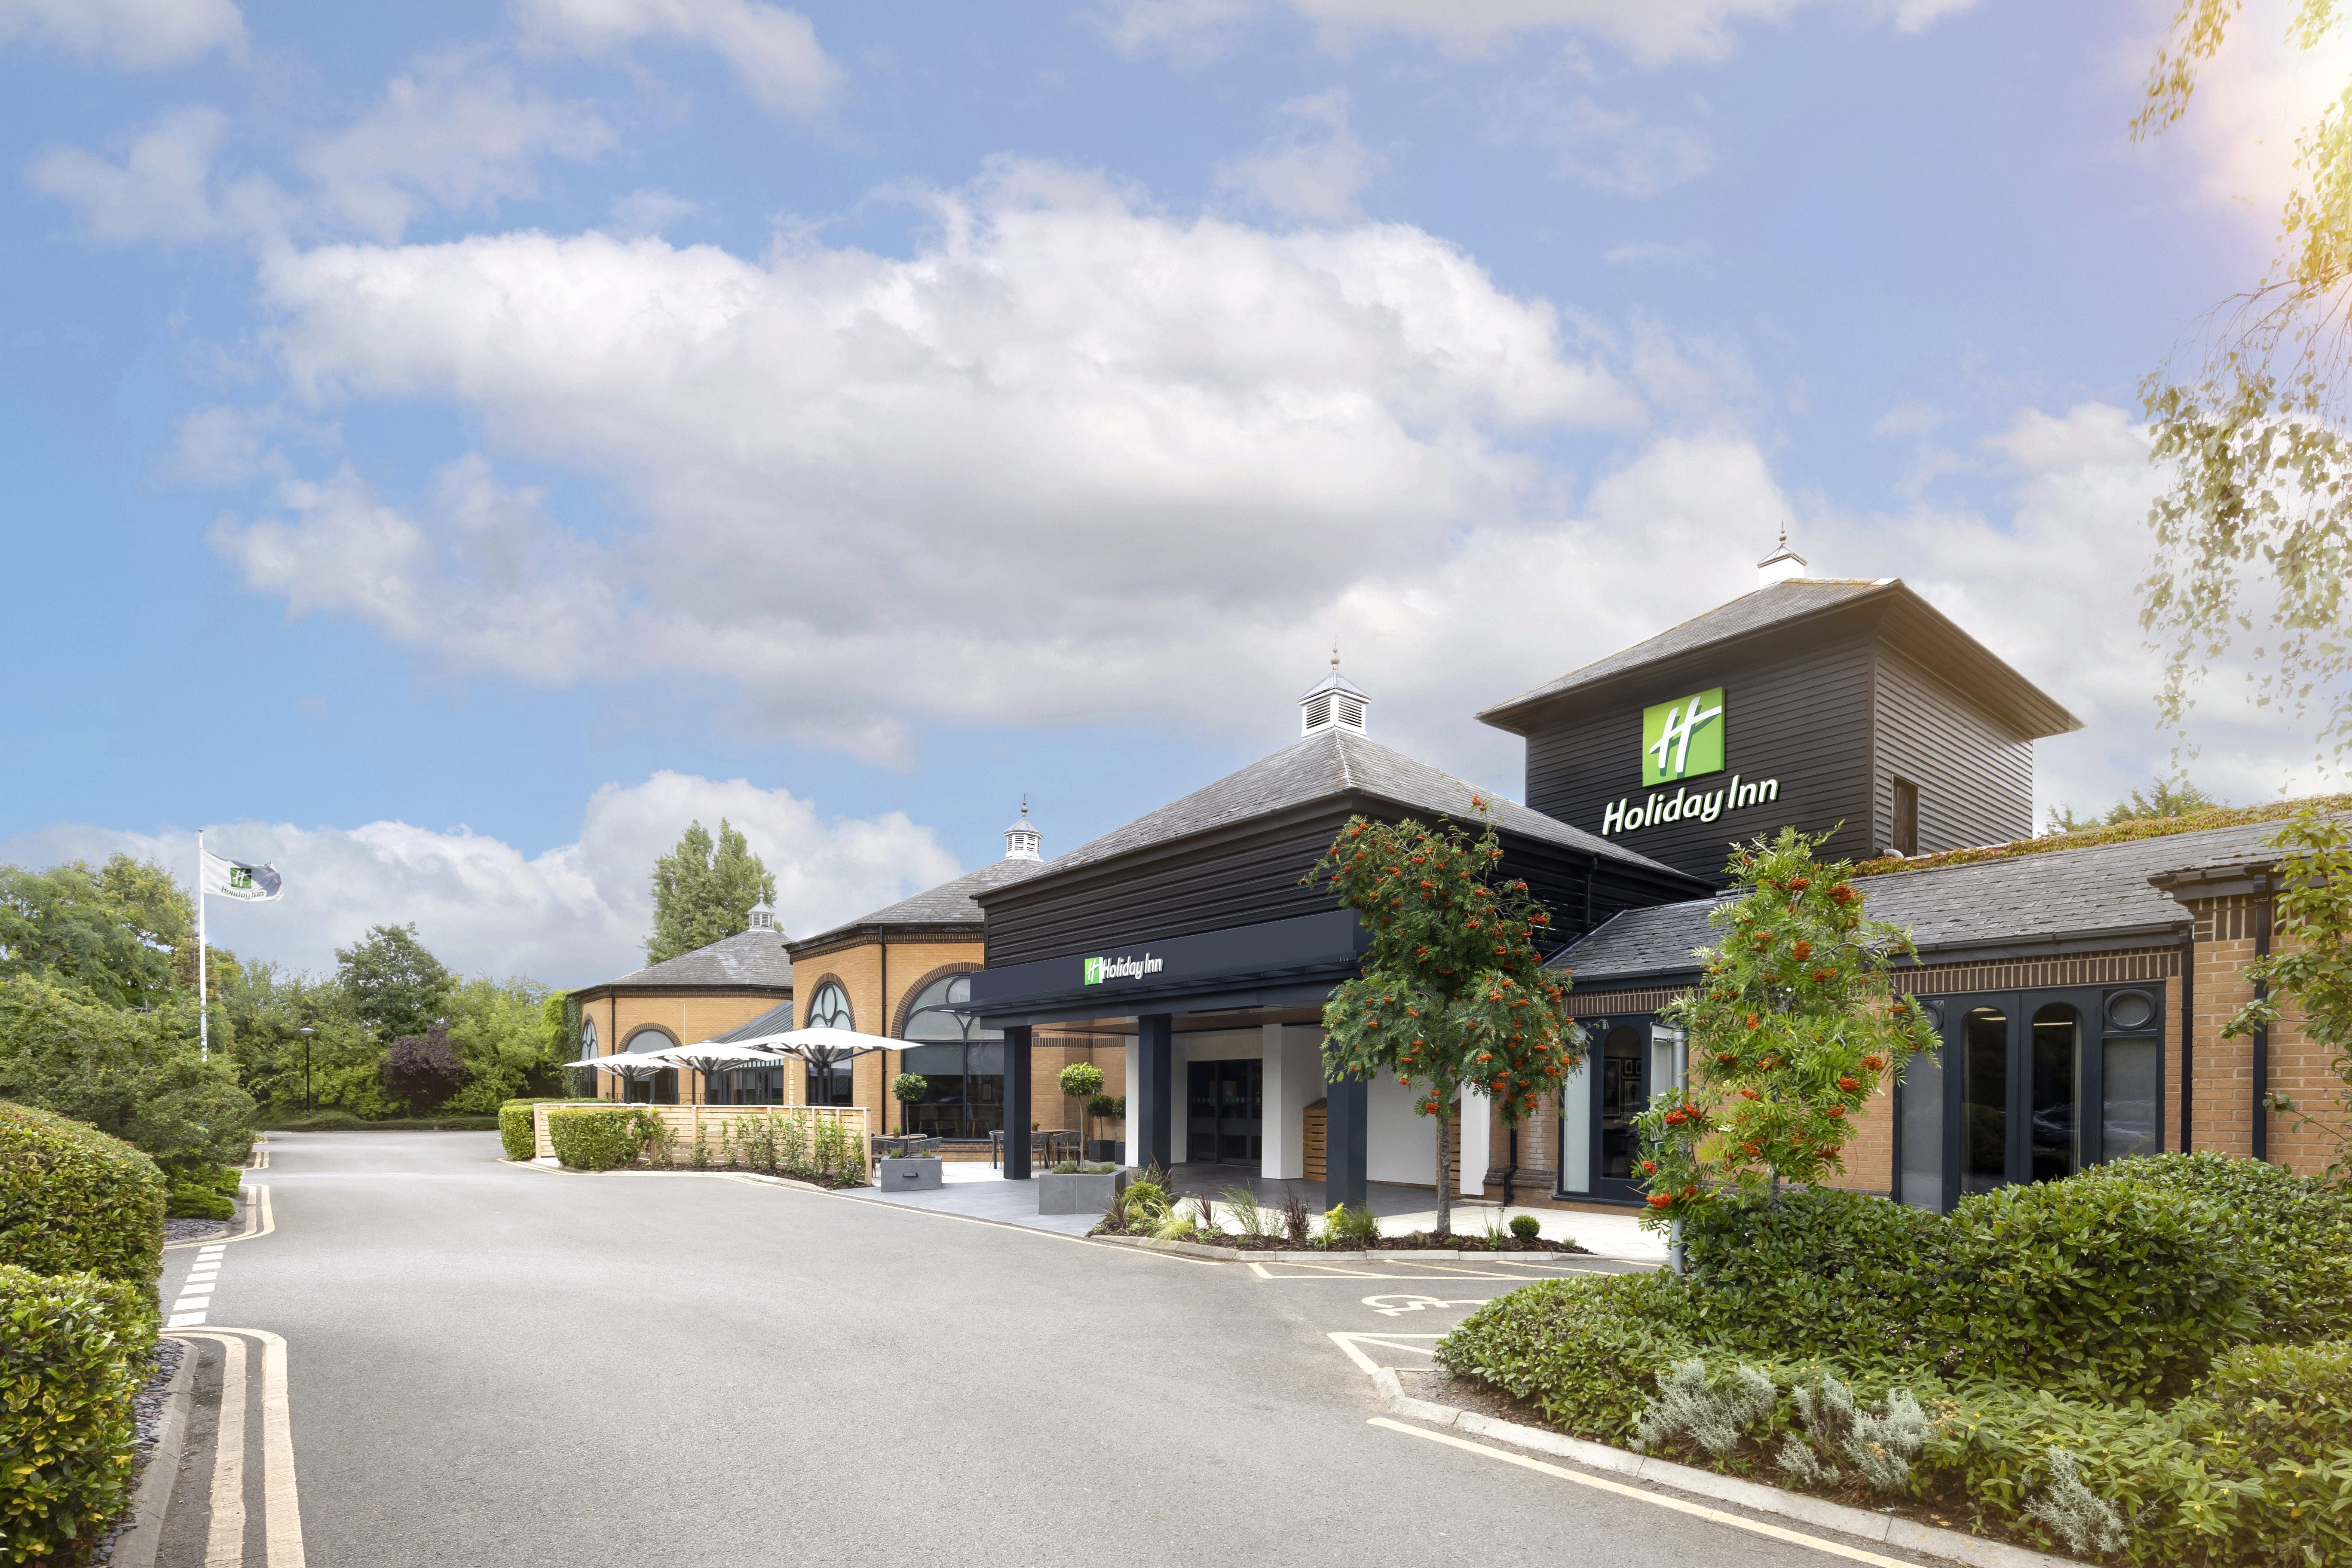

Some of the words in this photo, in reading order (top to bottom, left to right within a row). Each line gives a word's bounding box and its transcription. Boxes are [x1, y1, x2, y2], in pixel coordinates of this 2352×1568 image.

[1602, 787, 1724, 835] Holiday
[1728, 775, 1779, 808] Inn
[221, 886, 250, 899] Holiday
[1102, 956, 1145, 979] Holiday
[1145, 952, 1163, 973] Inn
